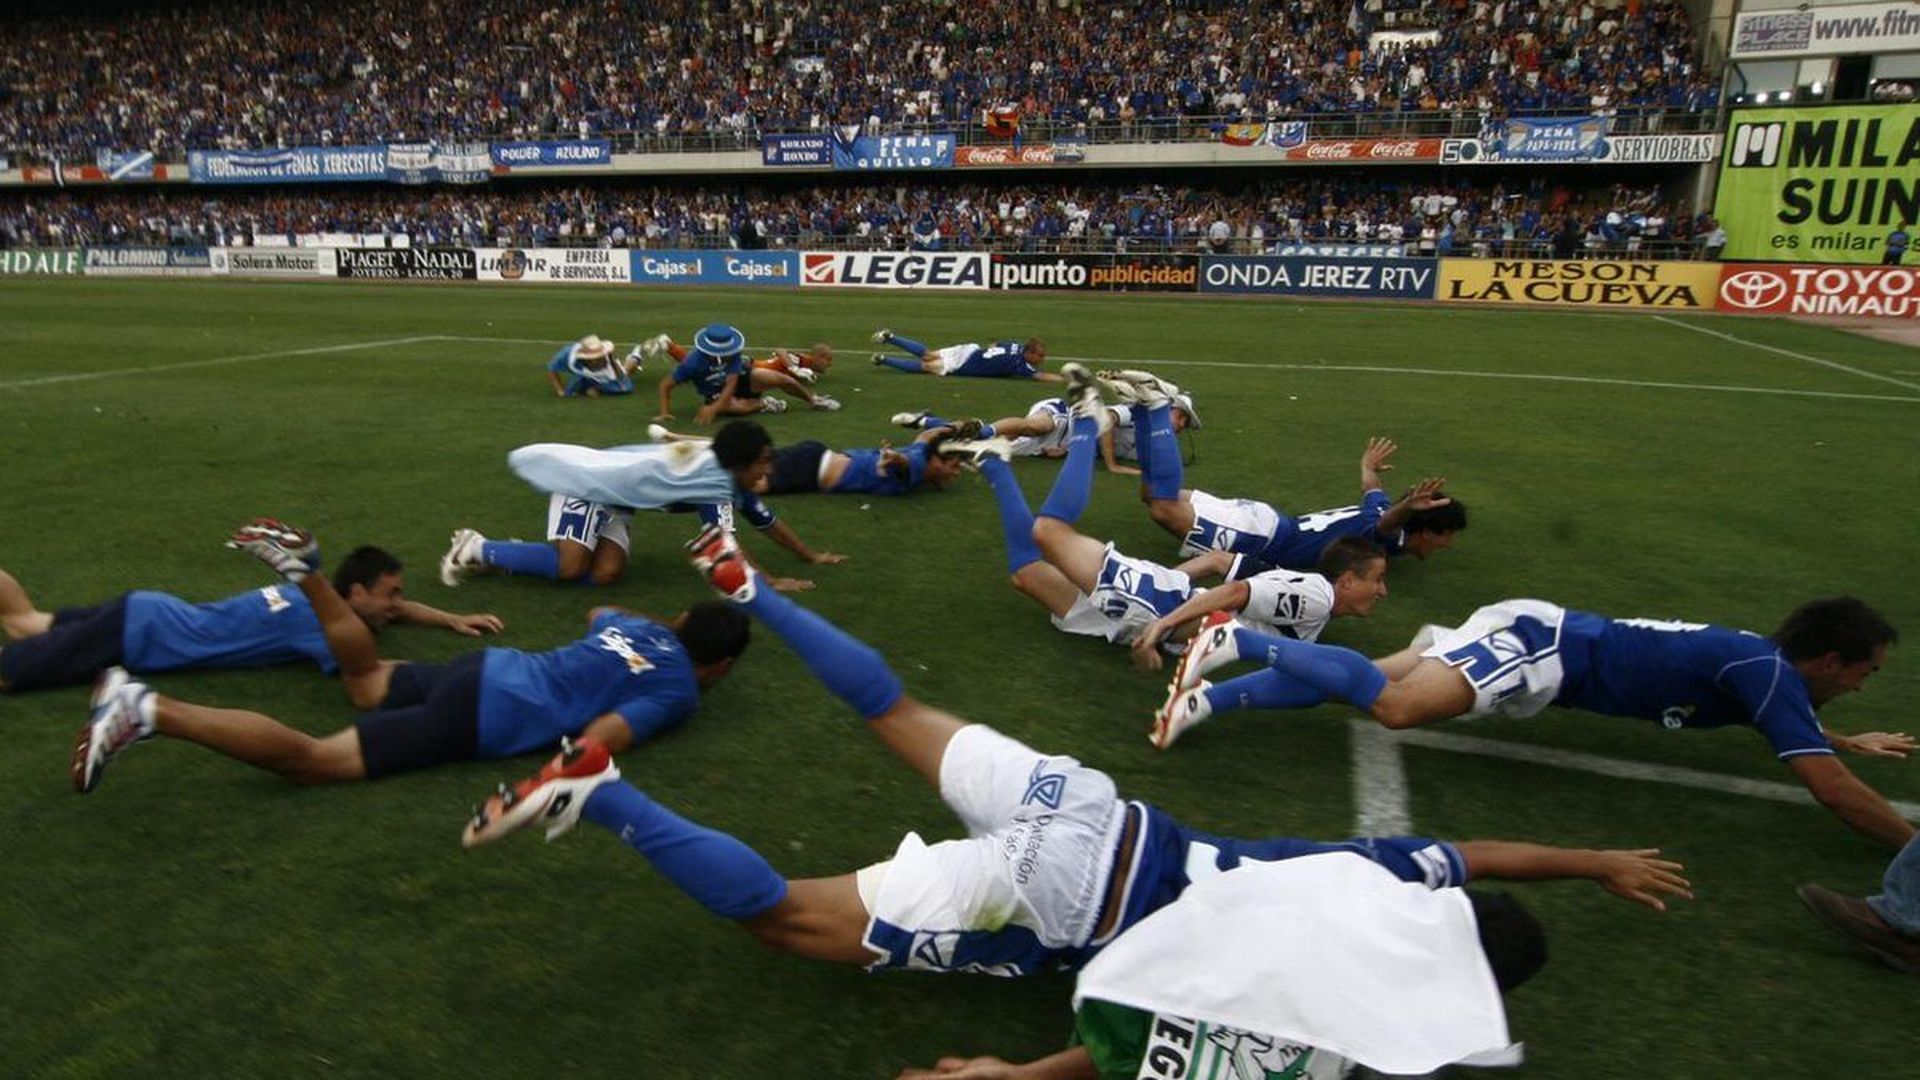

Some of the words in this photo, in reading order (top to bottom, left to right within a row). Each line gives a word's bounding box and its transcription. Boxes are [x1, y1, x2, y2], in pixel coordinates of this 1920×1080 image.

[500, 146, 540, 161] POWER
[556, 145, 600, 159] AZULINO
[1306, 143, 1352, 159] Coca-Cola
[1371, 142, 1419, 158] Coca-Cola
[1612, 137, 1713, 161] SERVIOBRAS
[858, 156, 932, 168] QUILLO
[1771, 233, 1799, 249] es
[1810, 232, 1881, 250] milar
[87, 248, 167, 266] PALOMINO
[233, 253, 274, 270] Solera
[276, 253, 314, 270] Motor
[340, 248, 396, 268] PIAGET
[413, 248, 474, 269] NADAL
[566, 250, 611, 263] EMPRESA
[551, 265, 562, 278] DE
[643, 257, 702, 280] Cajasol
[727, 259, 788, 281] Cajasol
[840, 254, 983, 286] LEGEA
[991, 255, 1086, 290] ipunto
[1089, 262, 1196, 286] publicidad
[1206, 263, 1292, 287] ONDA
[1299, 264, 1374, 290] JEREZ
[1379, 266, 1431, 291] RTV
[1494, 261, 1660, 282] MESON
[1450, 279, 1513, 301] LA
[1524, 281, 1701, 306] CUEVA
[1790, 268, 1920, 296] TOYO
